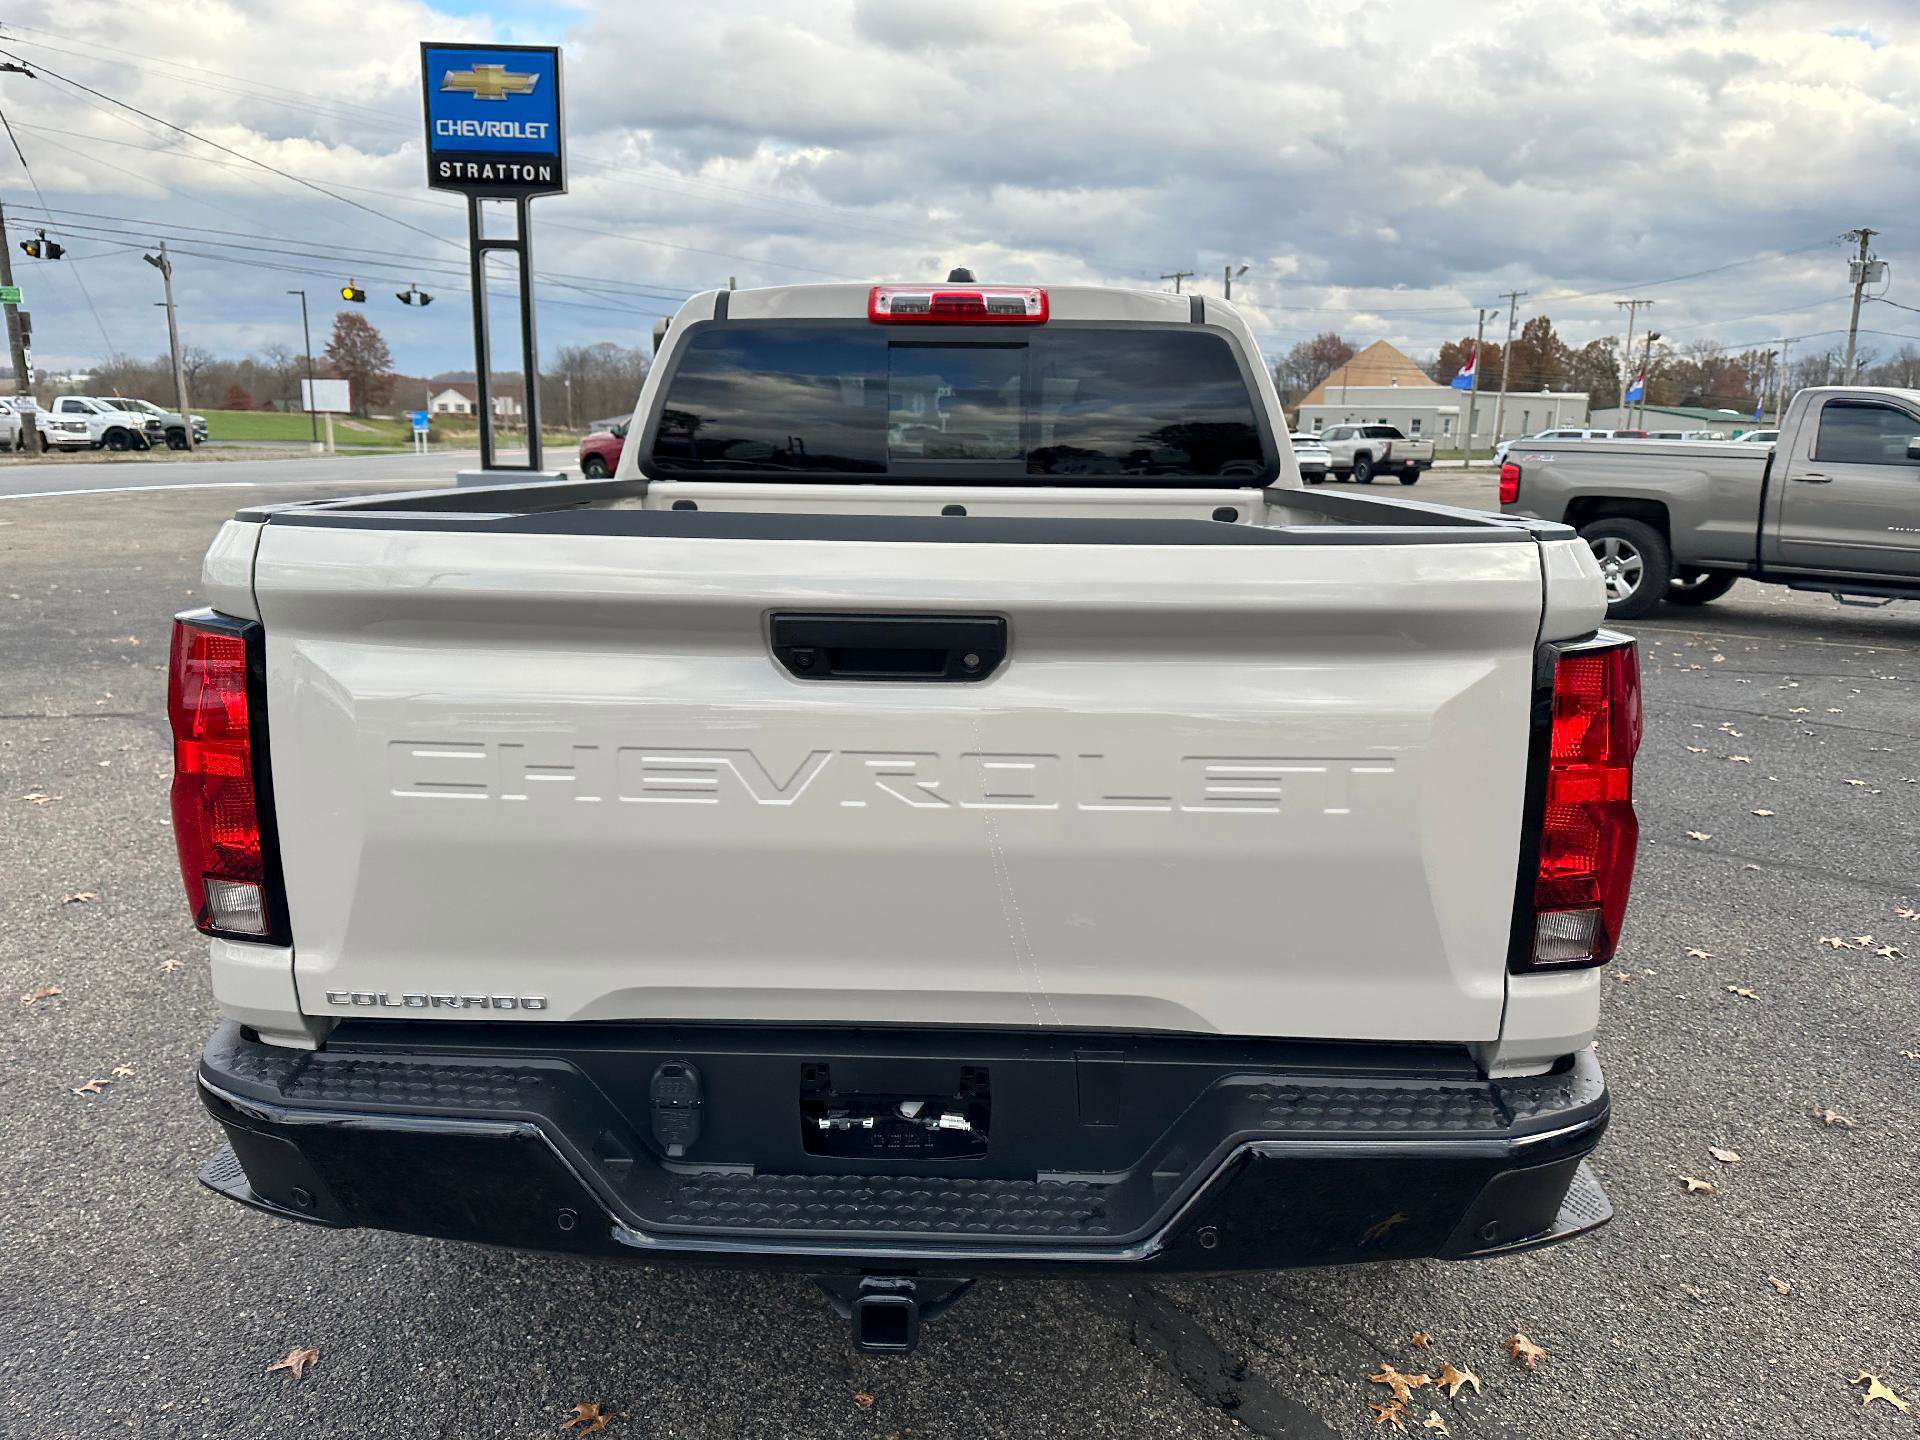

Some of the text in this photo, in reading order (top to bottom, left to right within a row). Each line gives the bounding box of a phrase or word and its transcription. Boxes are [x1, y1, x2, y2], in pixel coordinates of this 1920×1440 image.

[436, 119, 549, 139] CHEVROLET
[439, 161, 551, 181] STRATTON
[388, 740, 1397, 814] CHEVROLET
[325, 990, 548, 1010] COLORADO
